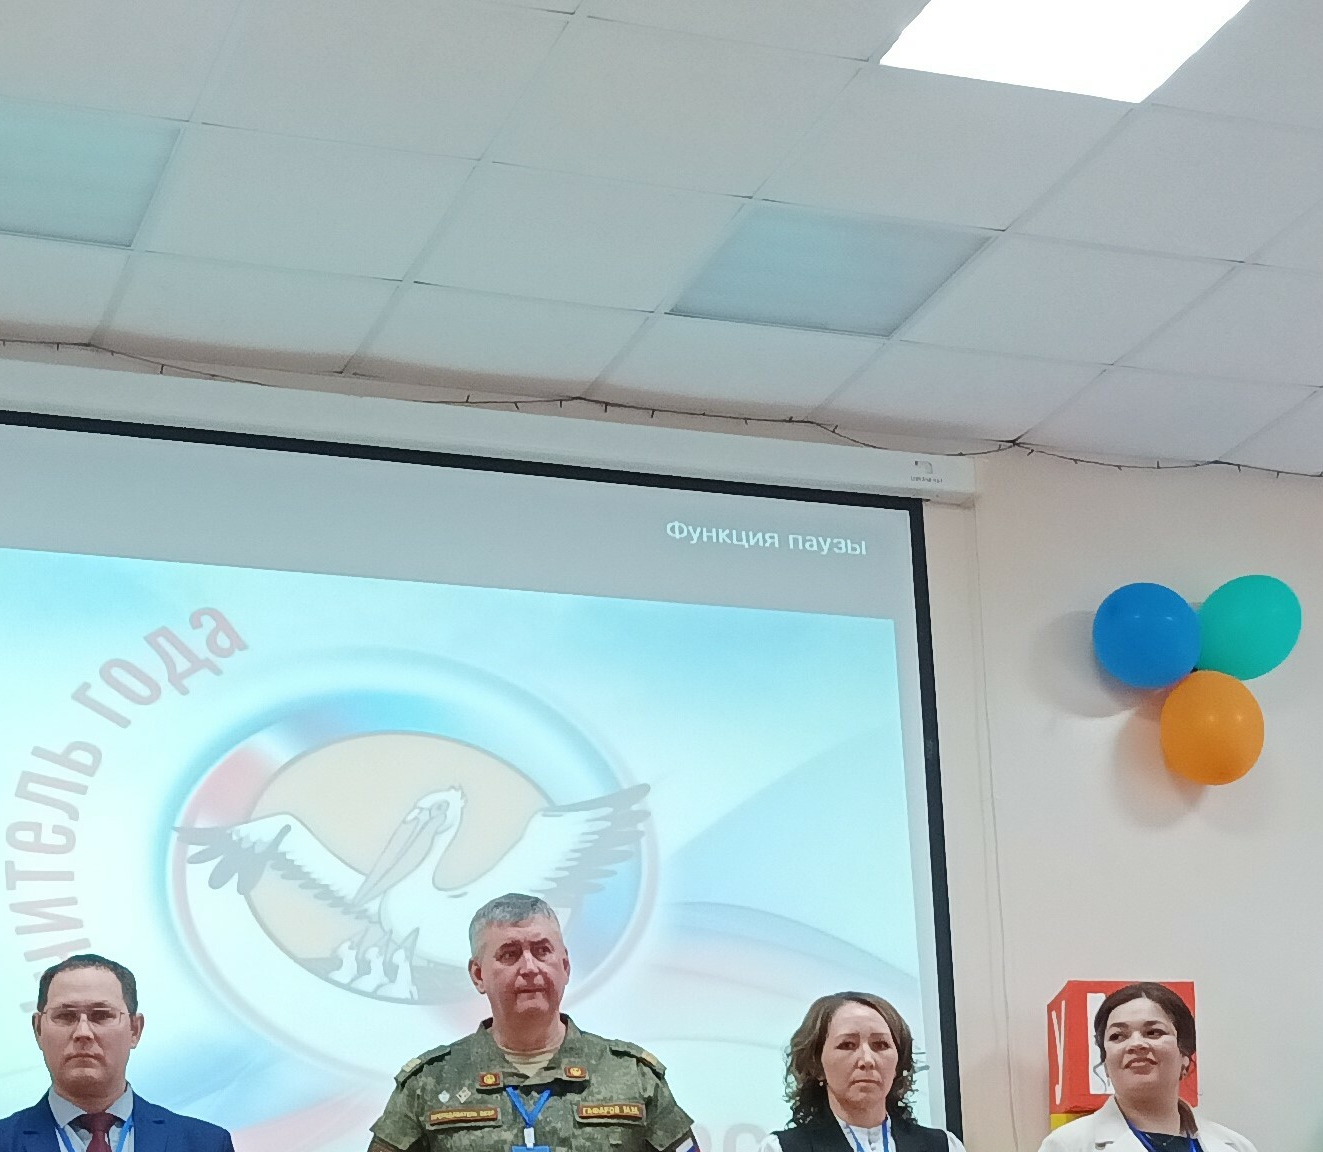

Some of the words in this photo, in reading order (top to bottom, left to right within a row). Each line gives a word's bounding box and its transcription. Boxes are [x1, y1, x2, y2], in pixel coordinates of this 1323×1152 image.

[665, 520, 780, 549] Функция
[788, 533, 868, 556] паузы
[71, 606, 249, 730] года
